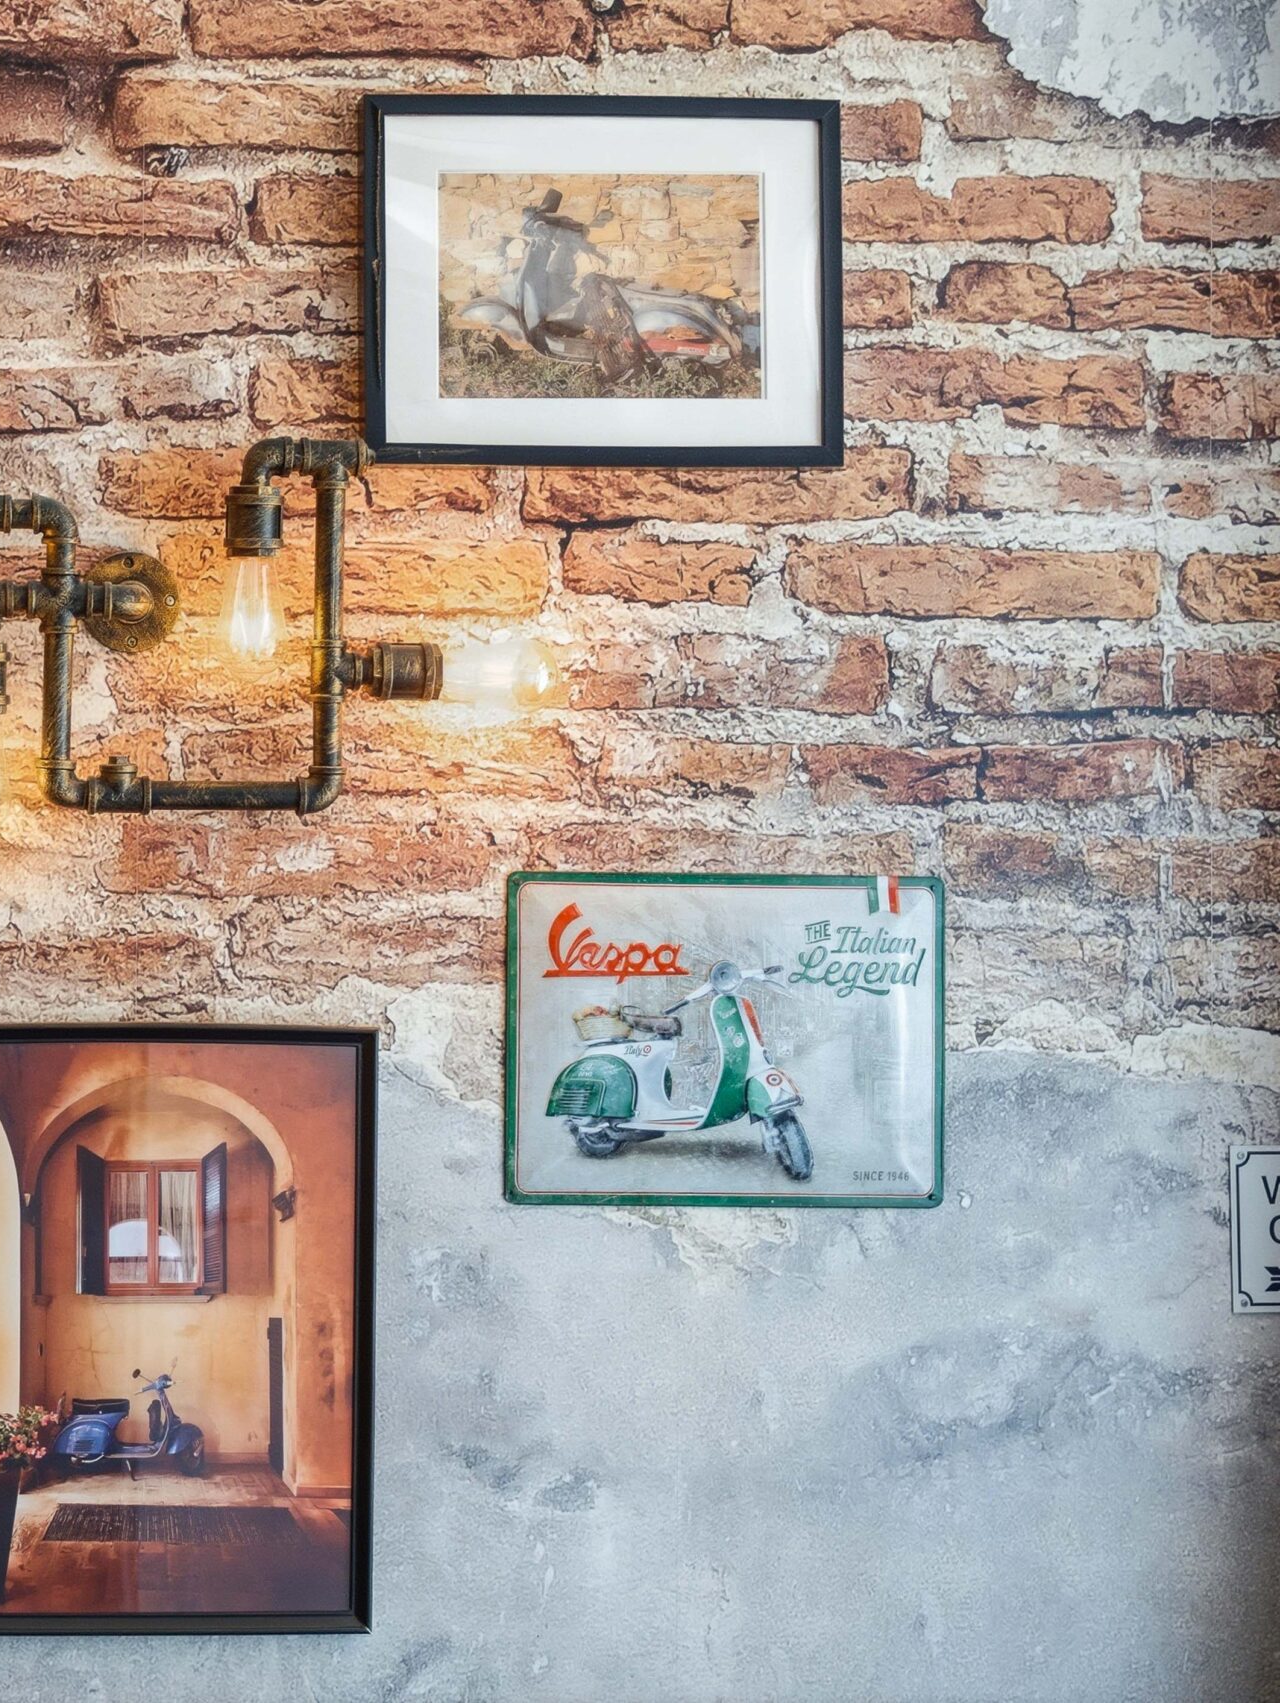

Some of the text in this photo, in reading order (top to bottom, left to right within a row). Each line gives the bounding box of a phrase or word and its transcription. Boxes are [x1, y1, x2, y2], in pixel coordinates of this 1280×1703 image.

[805, 923, 917, 956] THE Italian
[788, 946, 927, 998] Legend
[852, 1170, 910, 1182] SINCE 1946
